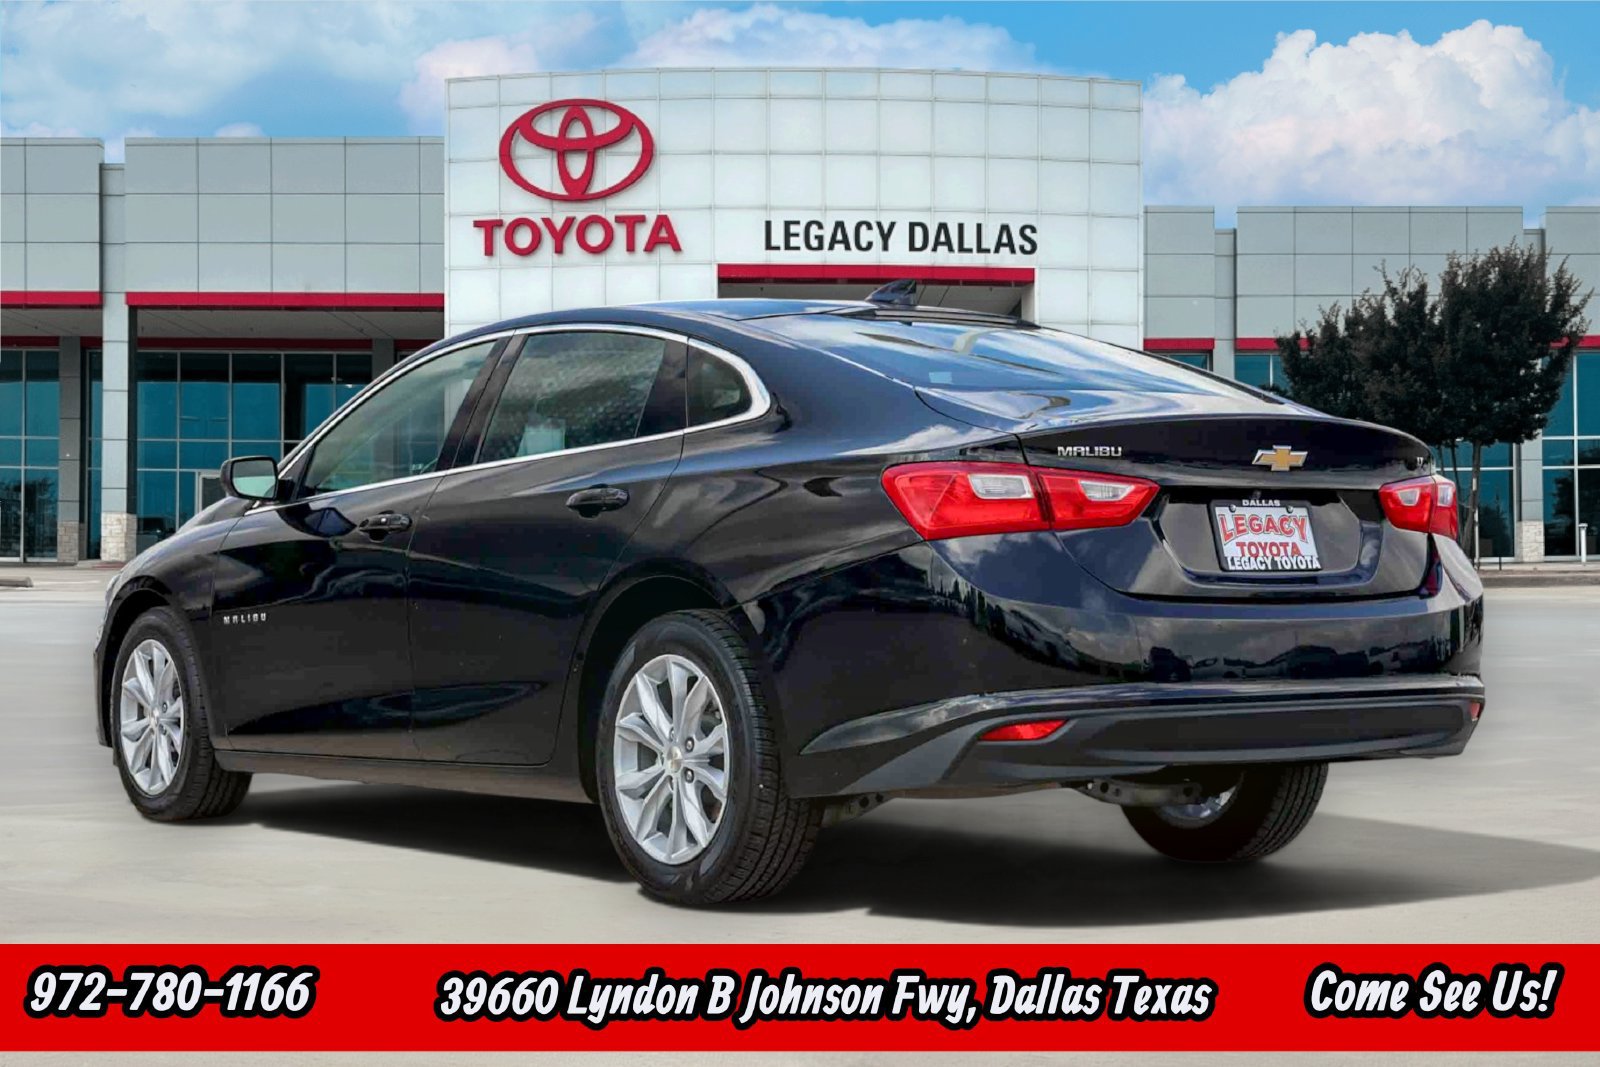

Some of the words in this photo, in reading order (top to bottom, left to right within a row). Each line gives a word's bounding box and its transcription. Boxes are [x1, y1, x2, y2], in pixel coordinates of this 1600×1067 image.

[474, 213, 682, 257] TOYOTA
[764, 220, 896, 252] LEGACY
[908, 221, 1038, 255] DALLAS
[1057, 445, 1123, 457] MALIBU
[1242, 499, 1281, 507] DALLAS
[1218, 514, 1308, 546] LEGACY
[1236, 541, 1303, 558] TOYOTA
[1227, 556, 1272, 570] LEGACY
[1275, 556, 1321, 569] TOYOTA
[223, 612, 266, 625] MALIBU
